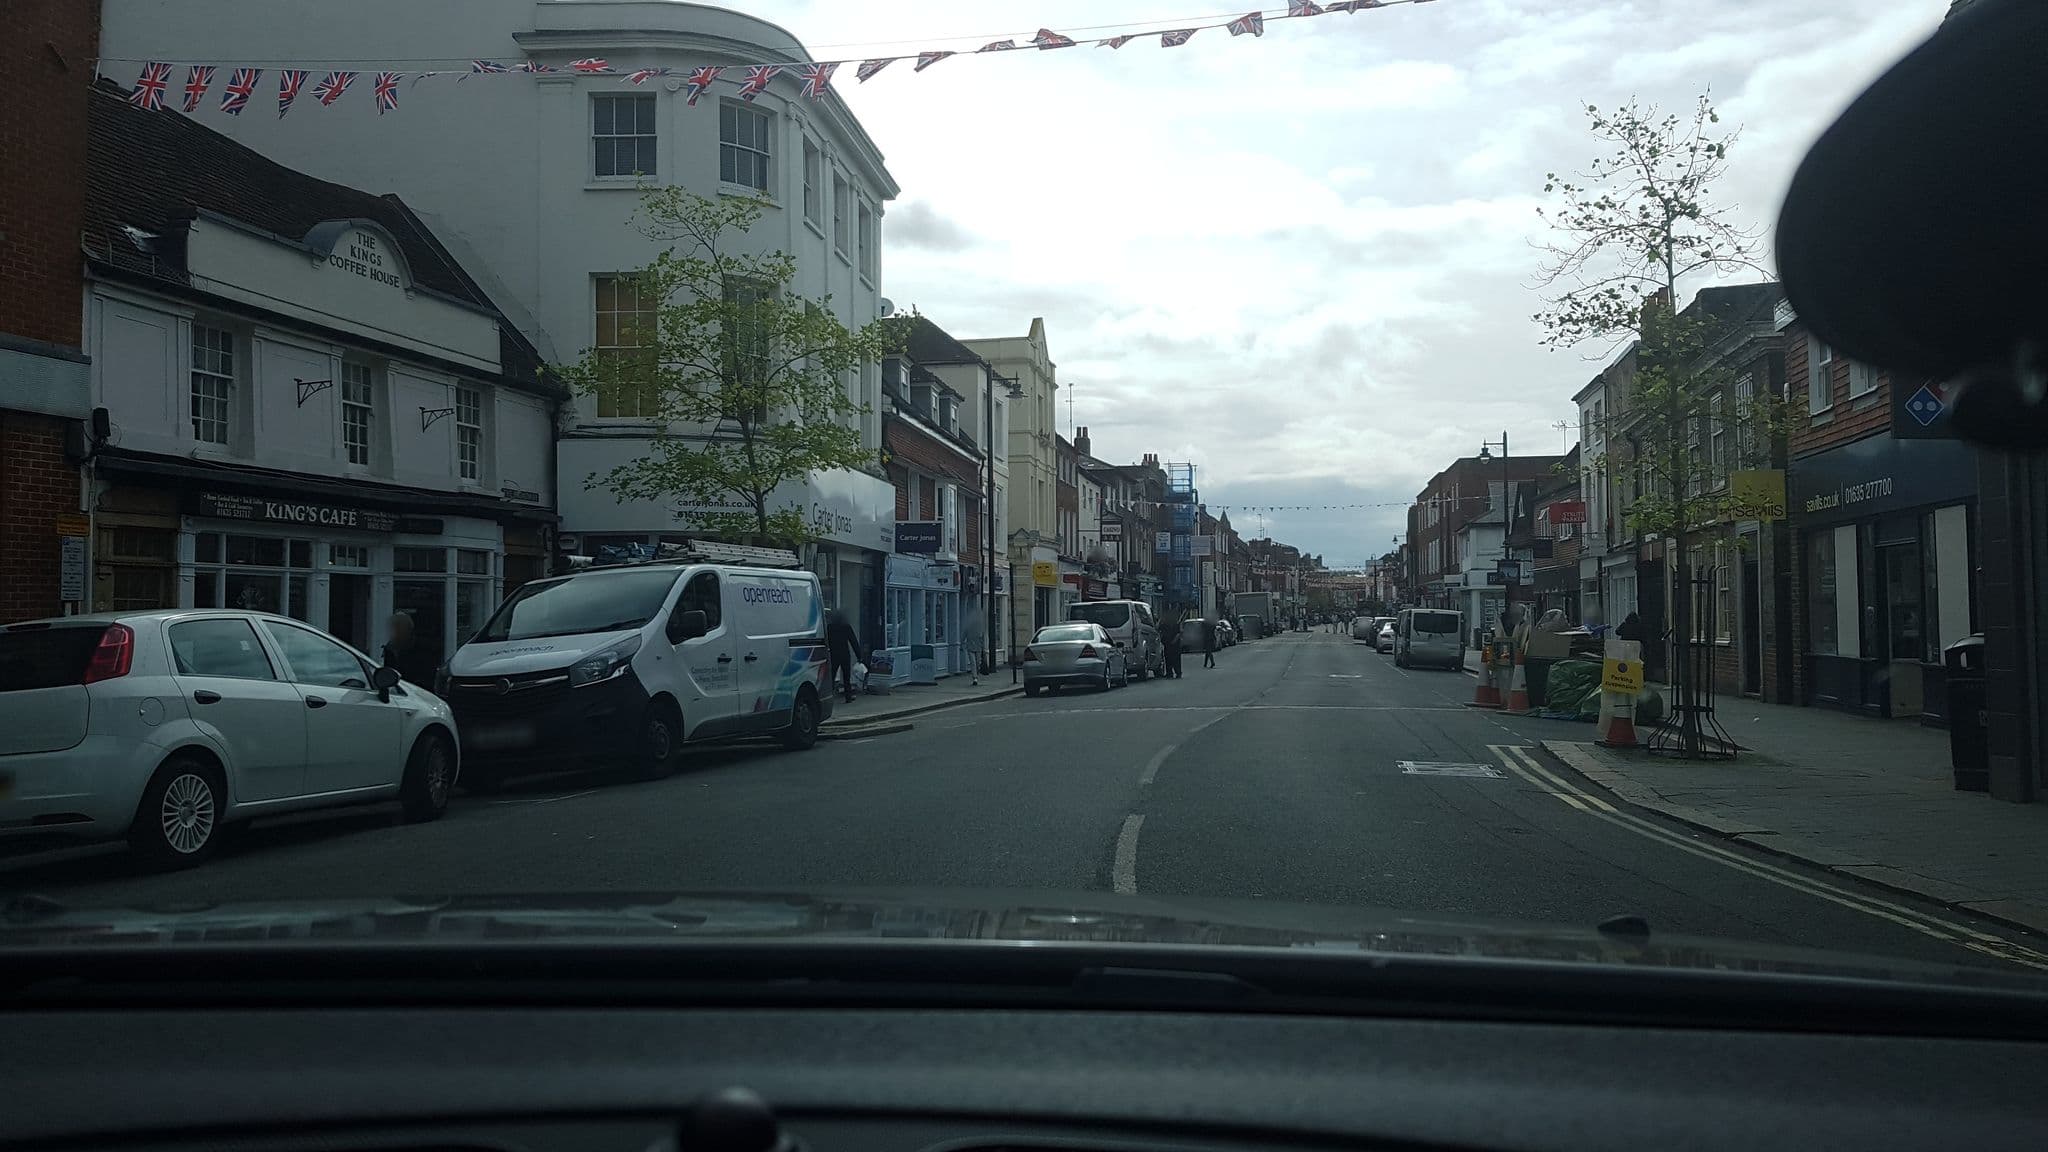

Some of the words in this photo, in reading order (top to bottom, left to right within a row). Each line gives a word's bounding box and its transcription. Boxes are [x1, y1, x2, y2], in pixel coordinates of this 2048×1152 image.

[356, 231, 376, 249] THE
[350, 244, 382, 266] KINGS
[329, 254, 367, 277] COFFEE
[370, 267, 400, 288] HOUSE
[1806, 490, 1840, 513] savills.co.uk
[1845, 487, 1864, 504] 01635
[1866, 477, 1893, 500] 277700
[319, 508, 358, 526] CAFÉ
[812, 502, 833, 530] Carter
[834, 507, 852, 535] Jonas
[899, 534, 918, 542] Carter
[918, 534, 936, 543] Jonas
[743, 587, 793, 605] openreach
[1611, 674, 1634, 683] Parking
